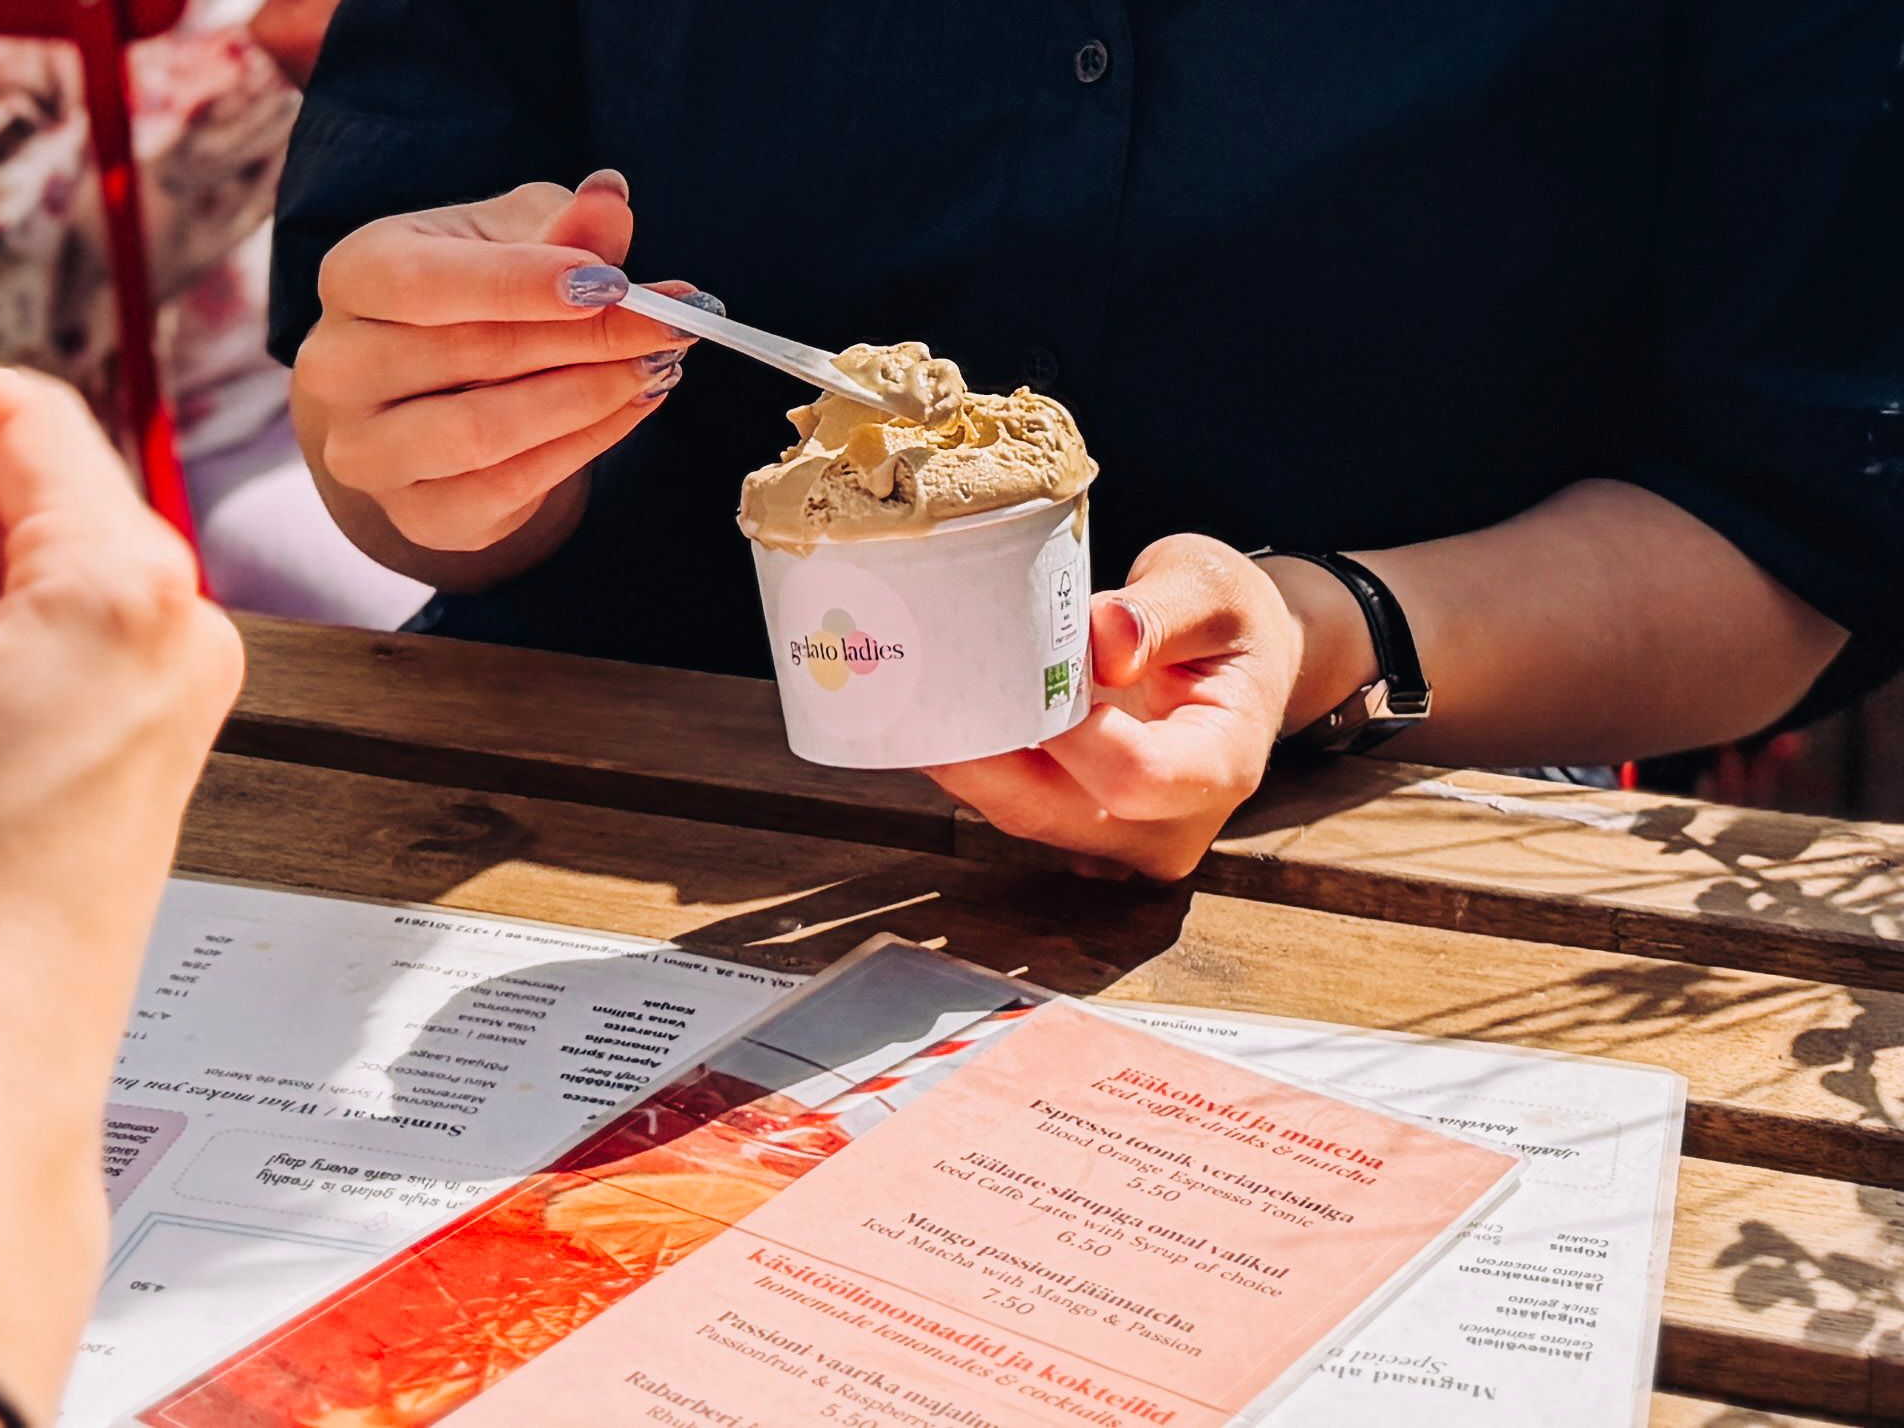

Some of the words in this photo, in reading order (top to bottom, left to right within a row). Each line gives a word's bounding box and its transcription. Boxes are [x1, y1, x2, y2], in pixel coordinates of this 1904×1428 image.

[790, 635, 838, 665] gelato
[841, 638, 904, 661] ladies
[663, 957, 708, 974] Tallinn
[738, 972, 765, 985] Uus
[494, 989, 556, 1006] Estonian
[592, 1005, 643, 1022] Tallinn
[642, 999, 696, 1016] Konjak
[457, 1014, 503, 1028] Massa
[508, 1021, 536, 1033] Villa
[648, 1014, 686, 1029] Vana
[476, 1031, 527, 1047] Kokteil
[604, 1022, 679, 1042] Amaretto
[584, 1033, 670, 1055] Limoncello
[559, 1045, 606, 1062] Spritz
[608, 1052, 662, 1069] Aperol
[203, 1067, 253, 1081] Merlot
[394, 1066, 462, 1085] Prosecco
[578, 1066, 613, 1078] beer
[614, 1071, 650, 1085] Craft
[111, 1076, 140, 1090] bu
[142, 1081, 188, 1093] you
[464, 1077, 498, 1089] Mini
[186, 1085, 255, 1105] makes
[412, 1086, 486, 1104] Marrenon
[257, 1095, 318, 1115] What
[1107, 1068, 1249, 1124] jääkohvid
[1242, 1115, 1277, 1135] ja
[1279, 1128, 1385, 1171] matcha
[1137, 1097, 1201, 1125] coffee
[1200, 1119, 1270, 1149] drinks
[1271, 1143, 1294, 1156] &
[1292, 1151, 1378, 1186] matcha
[265, 1153, 306, 1170] day!
[310, 1158, 359, 1176] every
[1029, 1098, 1122, 1142] Espresso
[1125, 1136, 1196, 1168] toonik
[1202, 1163, 1354, 1225] veriapelsiniga
[256, 1169, 315, 1191] freshly
[1036, 1121, 1095, 1148] Blood
[1097, 1144, 1164, 1175] Orange
[1169, 1170, 1253, 1207] Espresso
[1260, 1200, 1314, 1229] Tonic
[321, 1181, 337, 1193] is
[340, 1184, 397, 1201] gelato
[1126, 1176, 1182, 1203] 5.50
[399, 1192, 440, 1208] style
[960, 1151, 1046, 1189] Jäälatte
[1046, 1188, 1144, 1230] siirupiga
[1146, 1224, 1208, 1250] omal
[1210, 1245, 1291, 1280] valikul
[932, 1159, 976, 1181] Iced
[1028, 1197, 1077, 1223] Latte
[1083, 1218, 1125, 1241] with
[1129, 1235, 1189, 1265] Syrup
[1194, 1261, 1219, 1273] of
[1219, 1269, 1283, 1298] choice
[1056, 1230, 1113, 1258] 6.50
[1557, 1233, 1610, 1248] Cookie
[1549, 1241, 1608, 1260] Küpsis
[901, 1212, 976, 1248] Mango
[976, 1245, 1077, 1286] passioni
[1067, 1280, 1196, 1334] jäämatcha
[1476, 1256, 1548, 1273] macaron
[1552, 1267, 1605, 1283] Gelato
[130, 1281, 165, 1293] 4.50
[860, 1217, 905, 1240] Iced
[906, 1235, 975, 1270] Matcha
[981, 1265, 1025, 1289] with
[1029, 1283, 1098, 1316] Mango
[1103, 1313, 1121, 1326] &
[1125, 1321, 1203, 1358] Passion
[981, 1287, 1036, 1315] 7.50
[1508, 1294, 1560, 1311] gelato
[1562, 1302, 1600, 1317] Stick
[1496, 1305, 1597, 1329] Pulgajäätis
[746, 1247, 1008, 1359] käsitöölimonaadid
[994, 1350, 1034, 1373] ja
[1037, 1363, 1177, 1426] kokteilid
[1458, 1323, 1536, 1342] sandwich
[1540, 1333, 1594, 1350] Gelato
[695, 1324, 809, 1380] Passionfruit
[811, 1375, 830, 1388] &
[753, 1275, 875, 1330] homemade
[872, 1323, 994, 1379] lemonades
[994, 1374, 1018, 1386] &
[1017, 1384, 1122, 1428] cocktails
[1348, 1348, 1448, 1375] Special
[1372, 1369, 1497, 1401] Magusad
[819, 1402, 880, 1428] 5.50
[902, 1391, 998, 1428] majali
